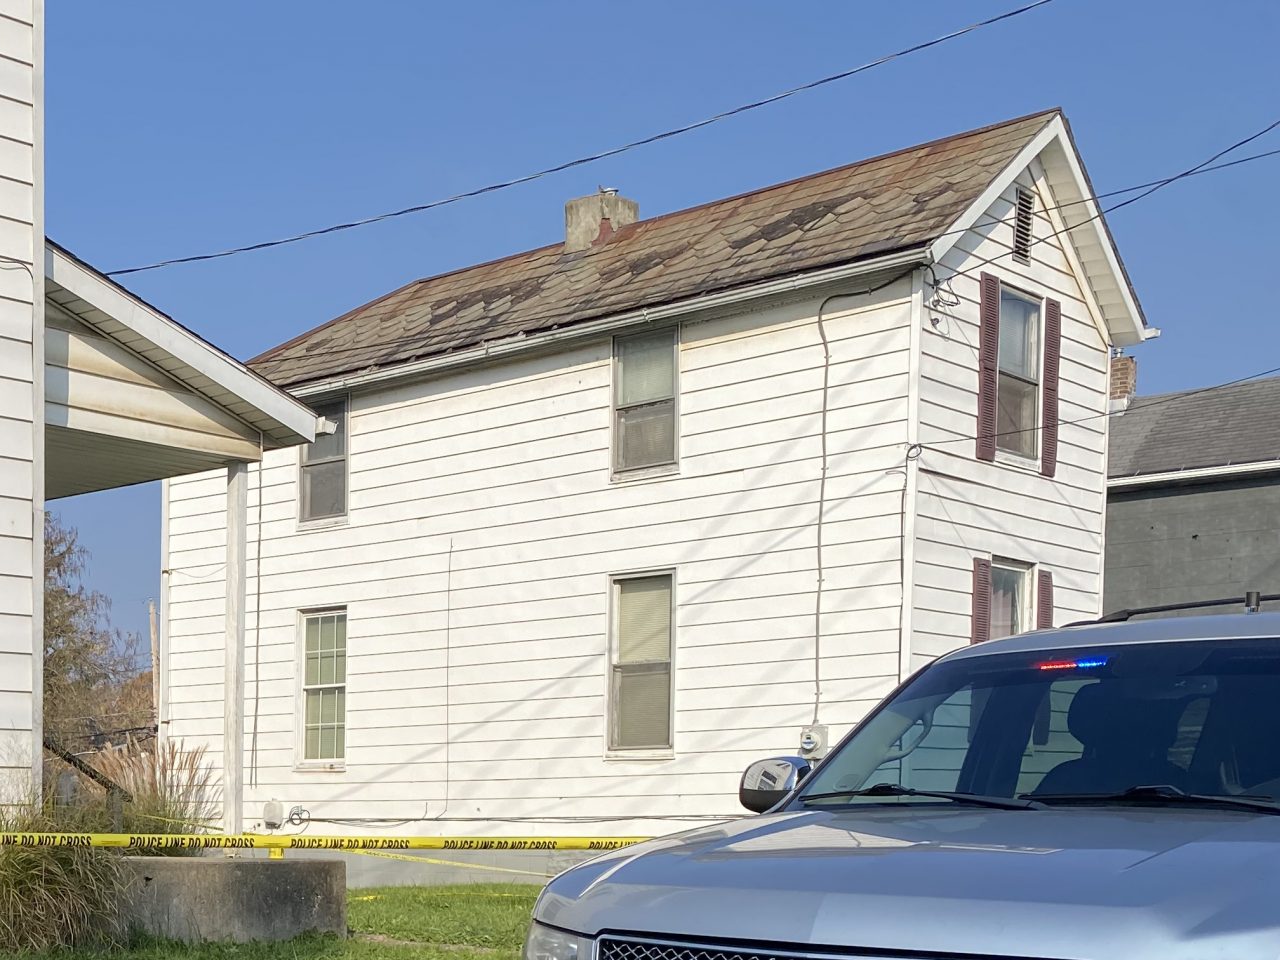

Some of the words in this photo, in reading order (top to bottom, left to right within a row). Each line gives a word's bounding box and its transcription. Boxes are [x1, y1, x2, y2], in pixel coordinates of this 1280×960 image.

[20, 835, 35, 846] DO
[37, 835, 58, 846] NOT
[59, 835, 93, 847] CROSS
[129, 836, 163, 848] POLICE
[165, 837, 186, 848] LINE
[187, 837, 202, 848] DO
[203, 837, 222, 848] NOT
[223, 838, 255, 849] CROSS
[290, 838, 323, 848] POLICE
[346, 839, 360, 849] DO
[361, 839, 380, 849] NOT
[380, 839, 410, 849] CROSS
[442, 840, 474, 850] POLICE
